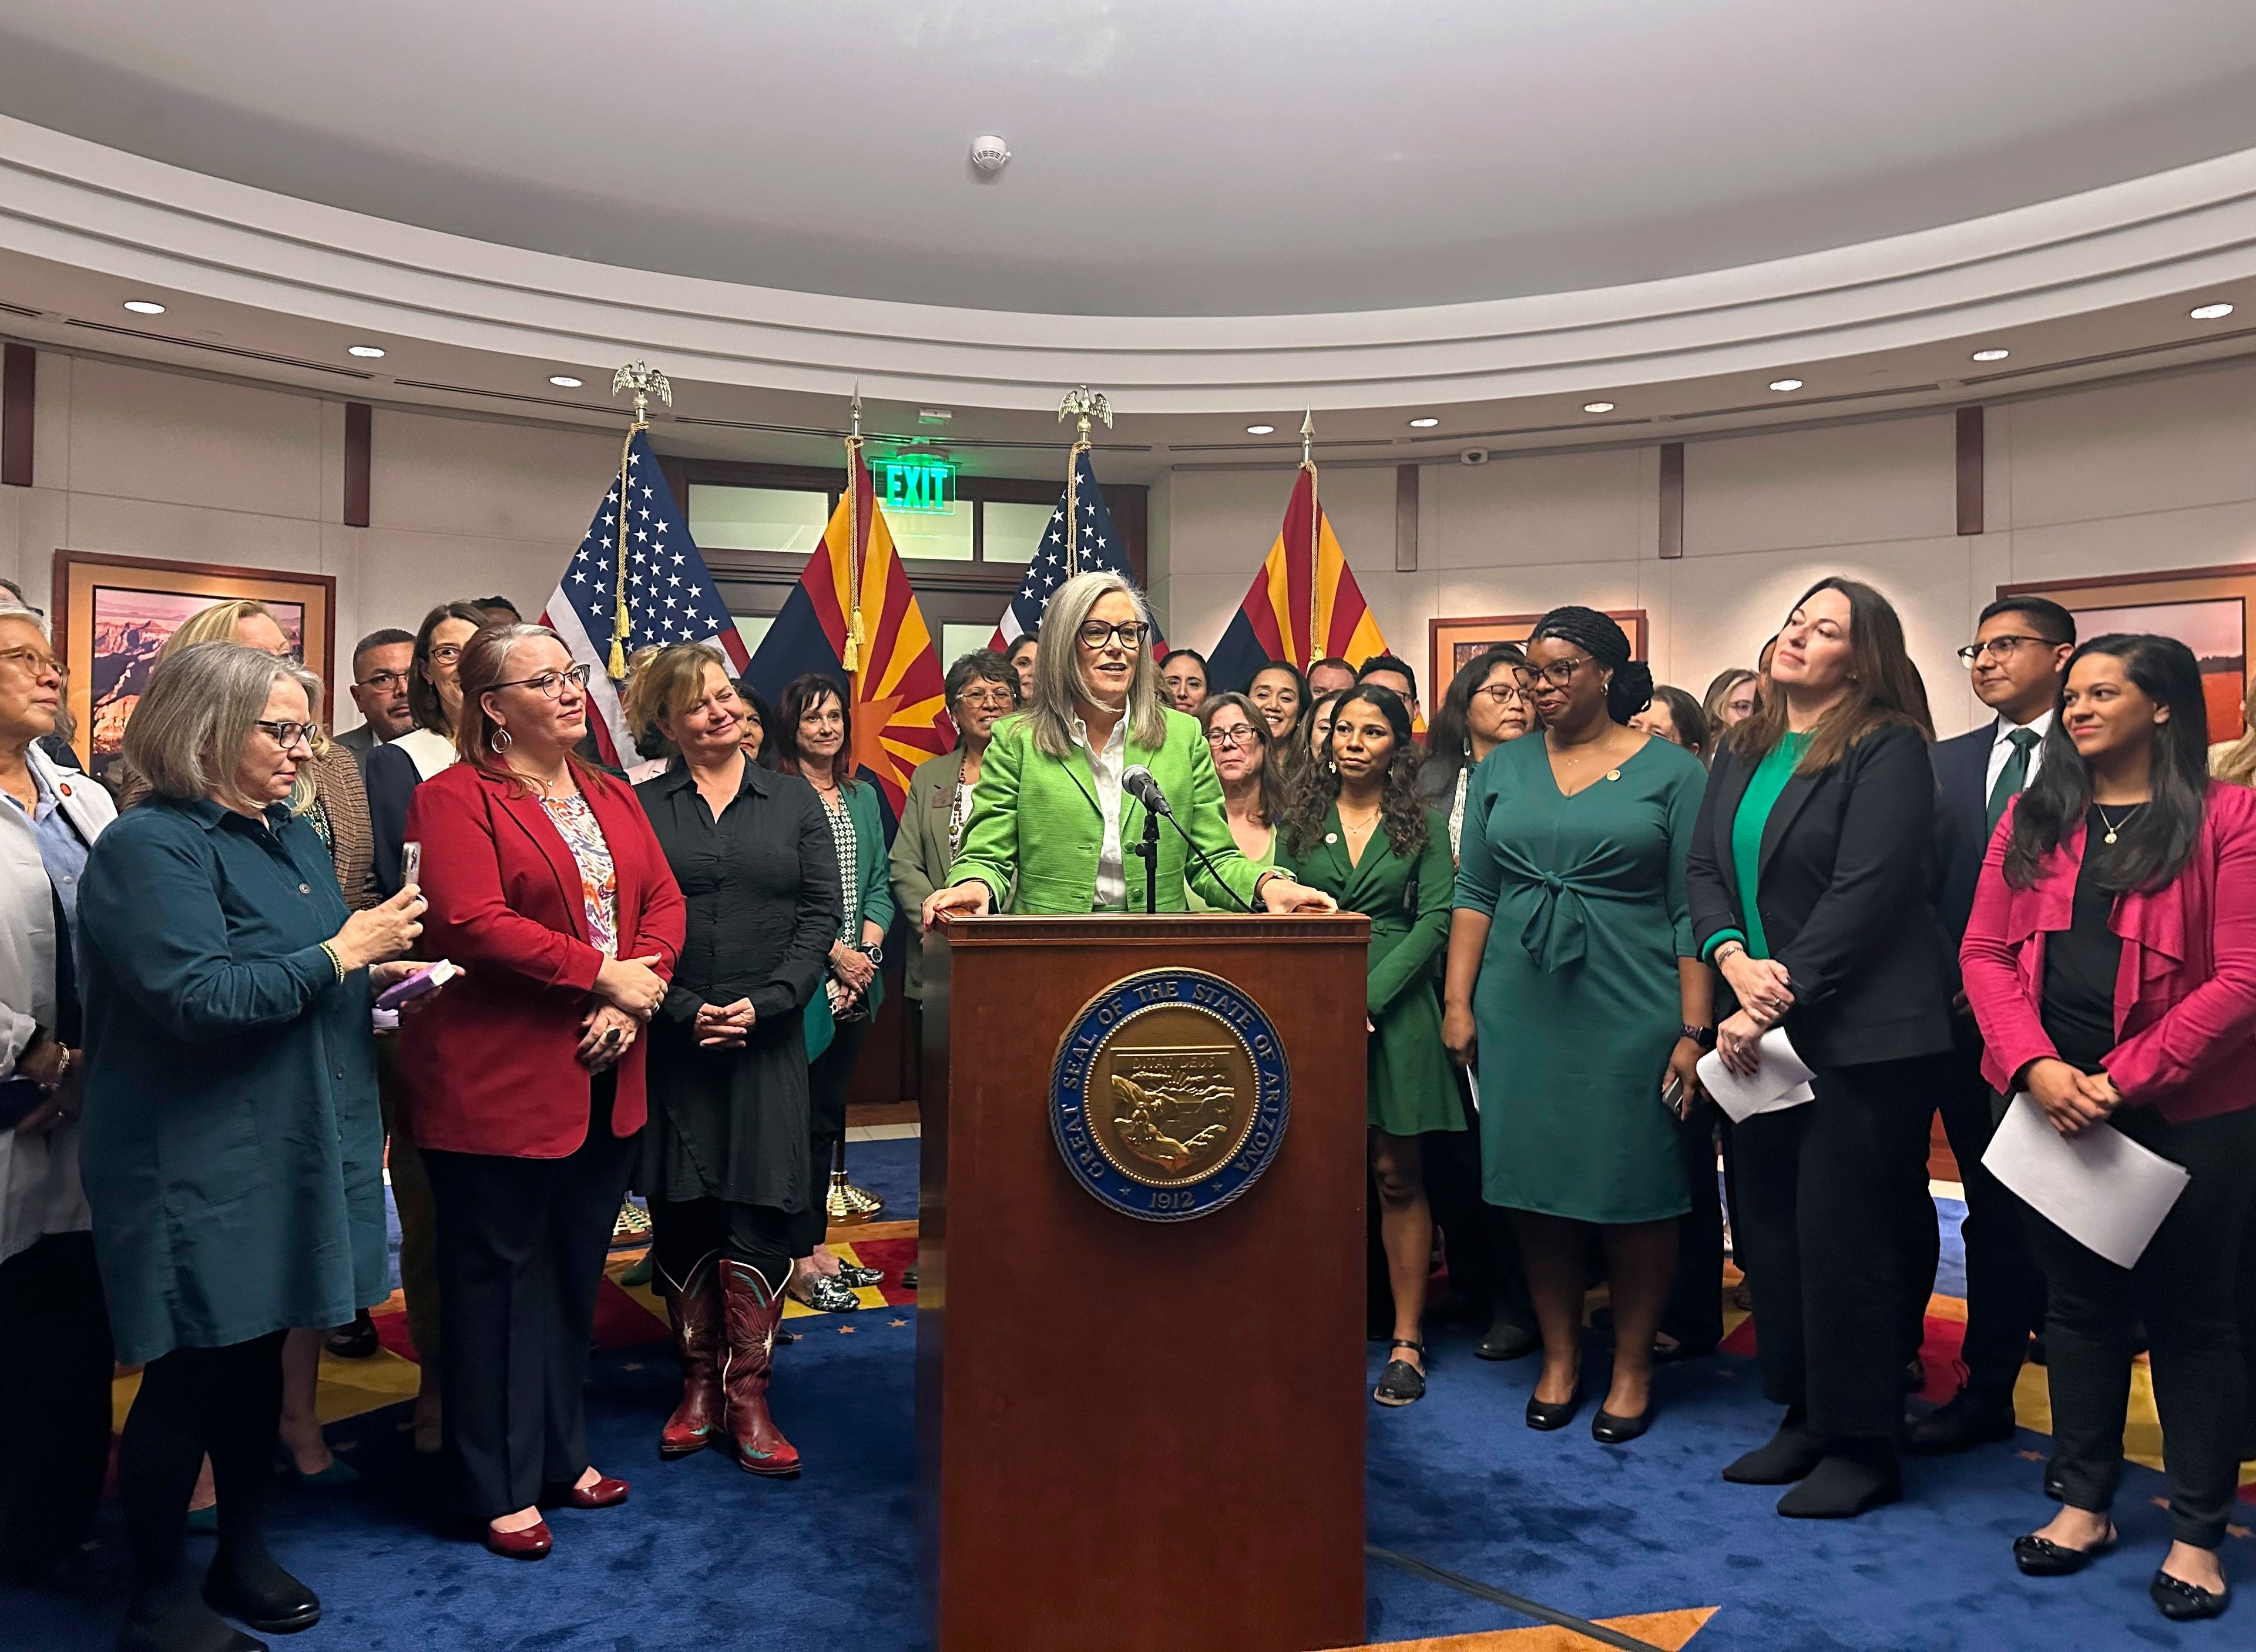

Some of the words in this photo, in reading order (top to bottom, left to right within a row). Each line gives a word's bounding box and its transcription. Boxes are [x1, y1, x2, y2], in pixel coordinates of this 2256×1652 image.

[887, 465, 948, 509] EXIT
[1097, 997, 1124, 1025] OF
[1133, 982, 1179, 1003] THE
[1192, 983, 1256, 1030] STATE
[1064, 1033, 1098, 1090] SEAL
[1254, 1033, 1276, 1062] OF
[1061, 1104, 1105, 1179] GREAT
[1233, 1071, 1280, 1173] ARIZONA
[1149, 1191, 1196, 1209] 1912
